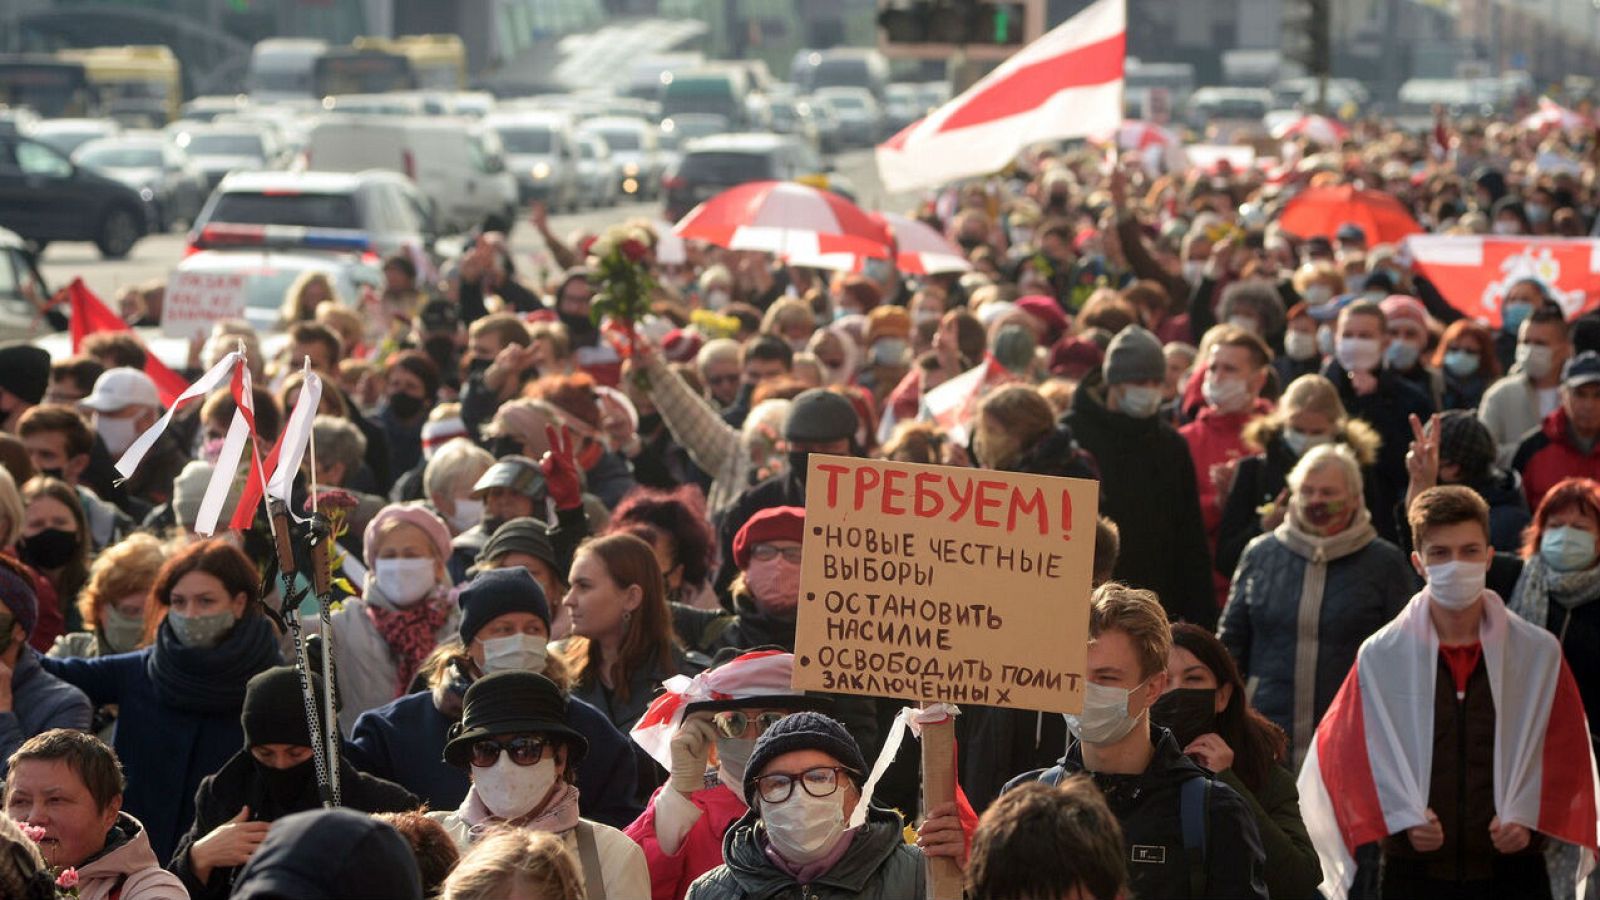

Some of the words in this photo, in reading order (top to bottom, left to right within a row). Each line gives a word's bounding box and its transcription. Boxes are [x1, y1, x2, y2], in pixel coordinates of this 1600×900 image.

[816, 464, 1072, 541] ТРЕБУЕМ!
[823, 555, 934, 586] ВЫБОРЫ
[825, 527, 915, 557] НОВЫЕ
[929, 537, 1063, 578] ЧЕСТНЫЕ
[824, 590, 1003, 630] ОСТАНОВИТЬ
[826, 618, 953, 650] НАСИЛИЕ
[818, 646, 993, 683] ОСВОБОДИТЬ
[1001, 664, 1082, 693] ПОЛИТ.
